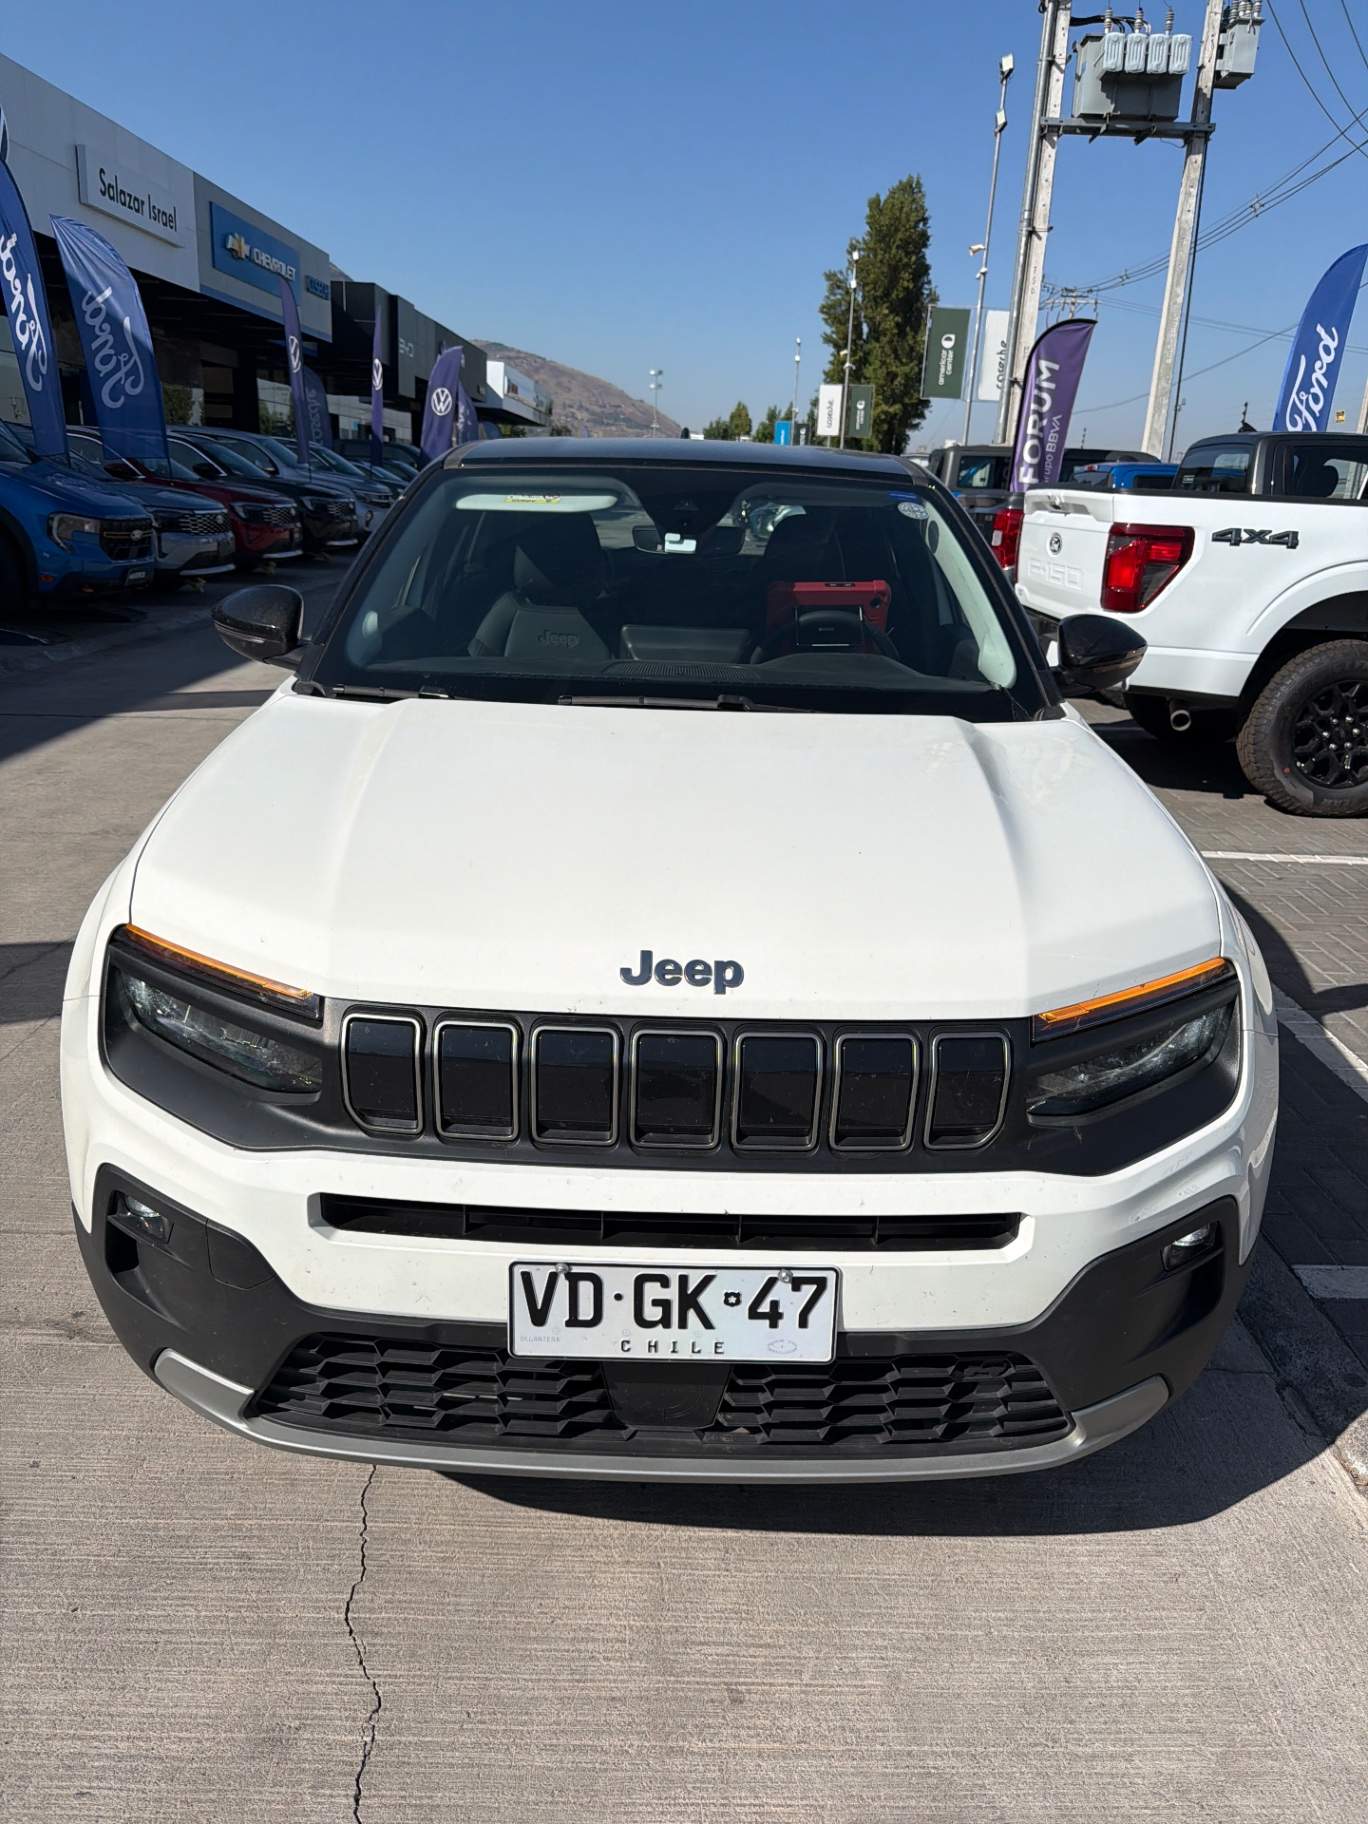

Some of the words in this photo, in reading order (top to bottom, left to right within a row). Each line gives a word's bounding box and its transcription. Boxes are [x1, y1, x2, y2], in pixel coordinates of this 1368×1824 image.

[99, 167, 145, 216] Salazar
[148, 193, 178, 232] Israel
[1286, 323, 1339, 432] Ford
[1019, 359, 1060, 484] FORUM
[1046, 414, 1063, 453] BBVA
[620, 949, 745, 995] Jeep
[620, 1339, 725, 1355] CHILE
